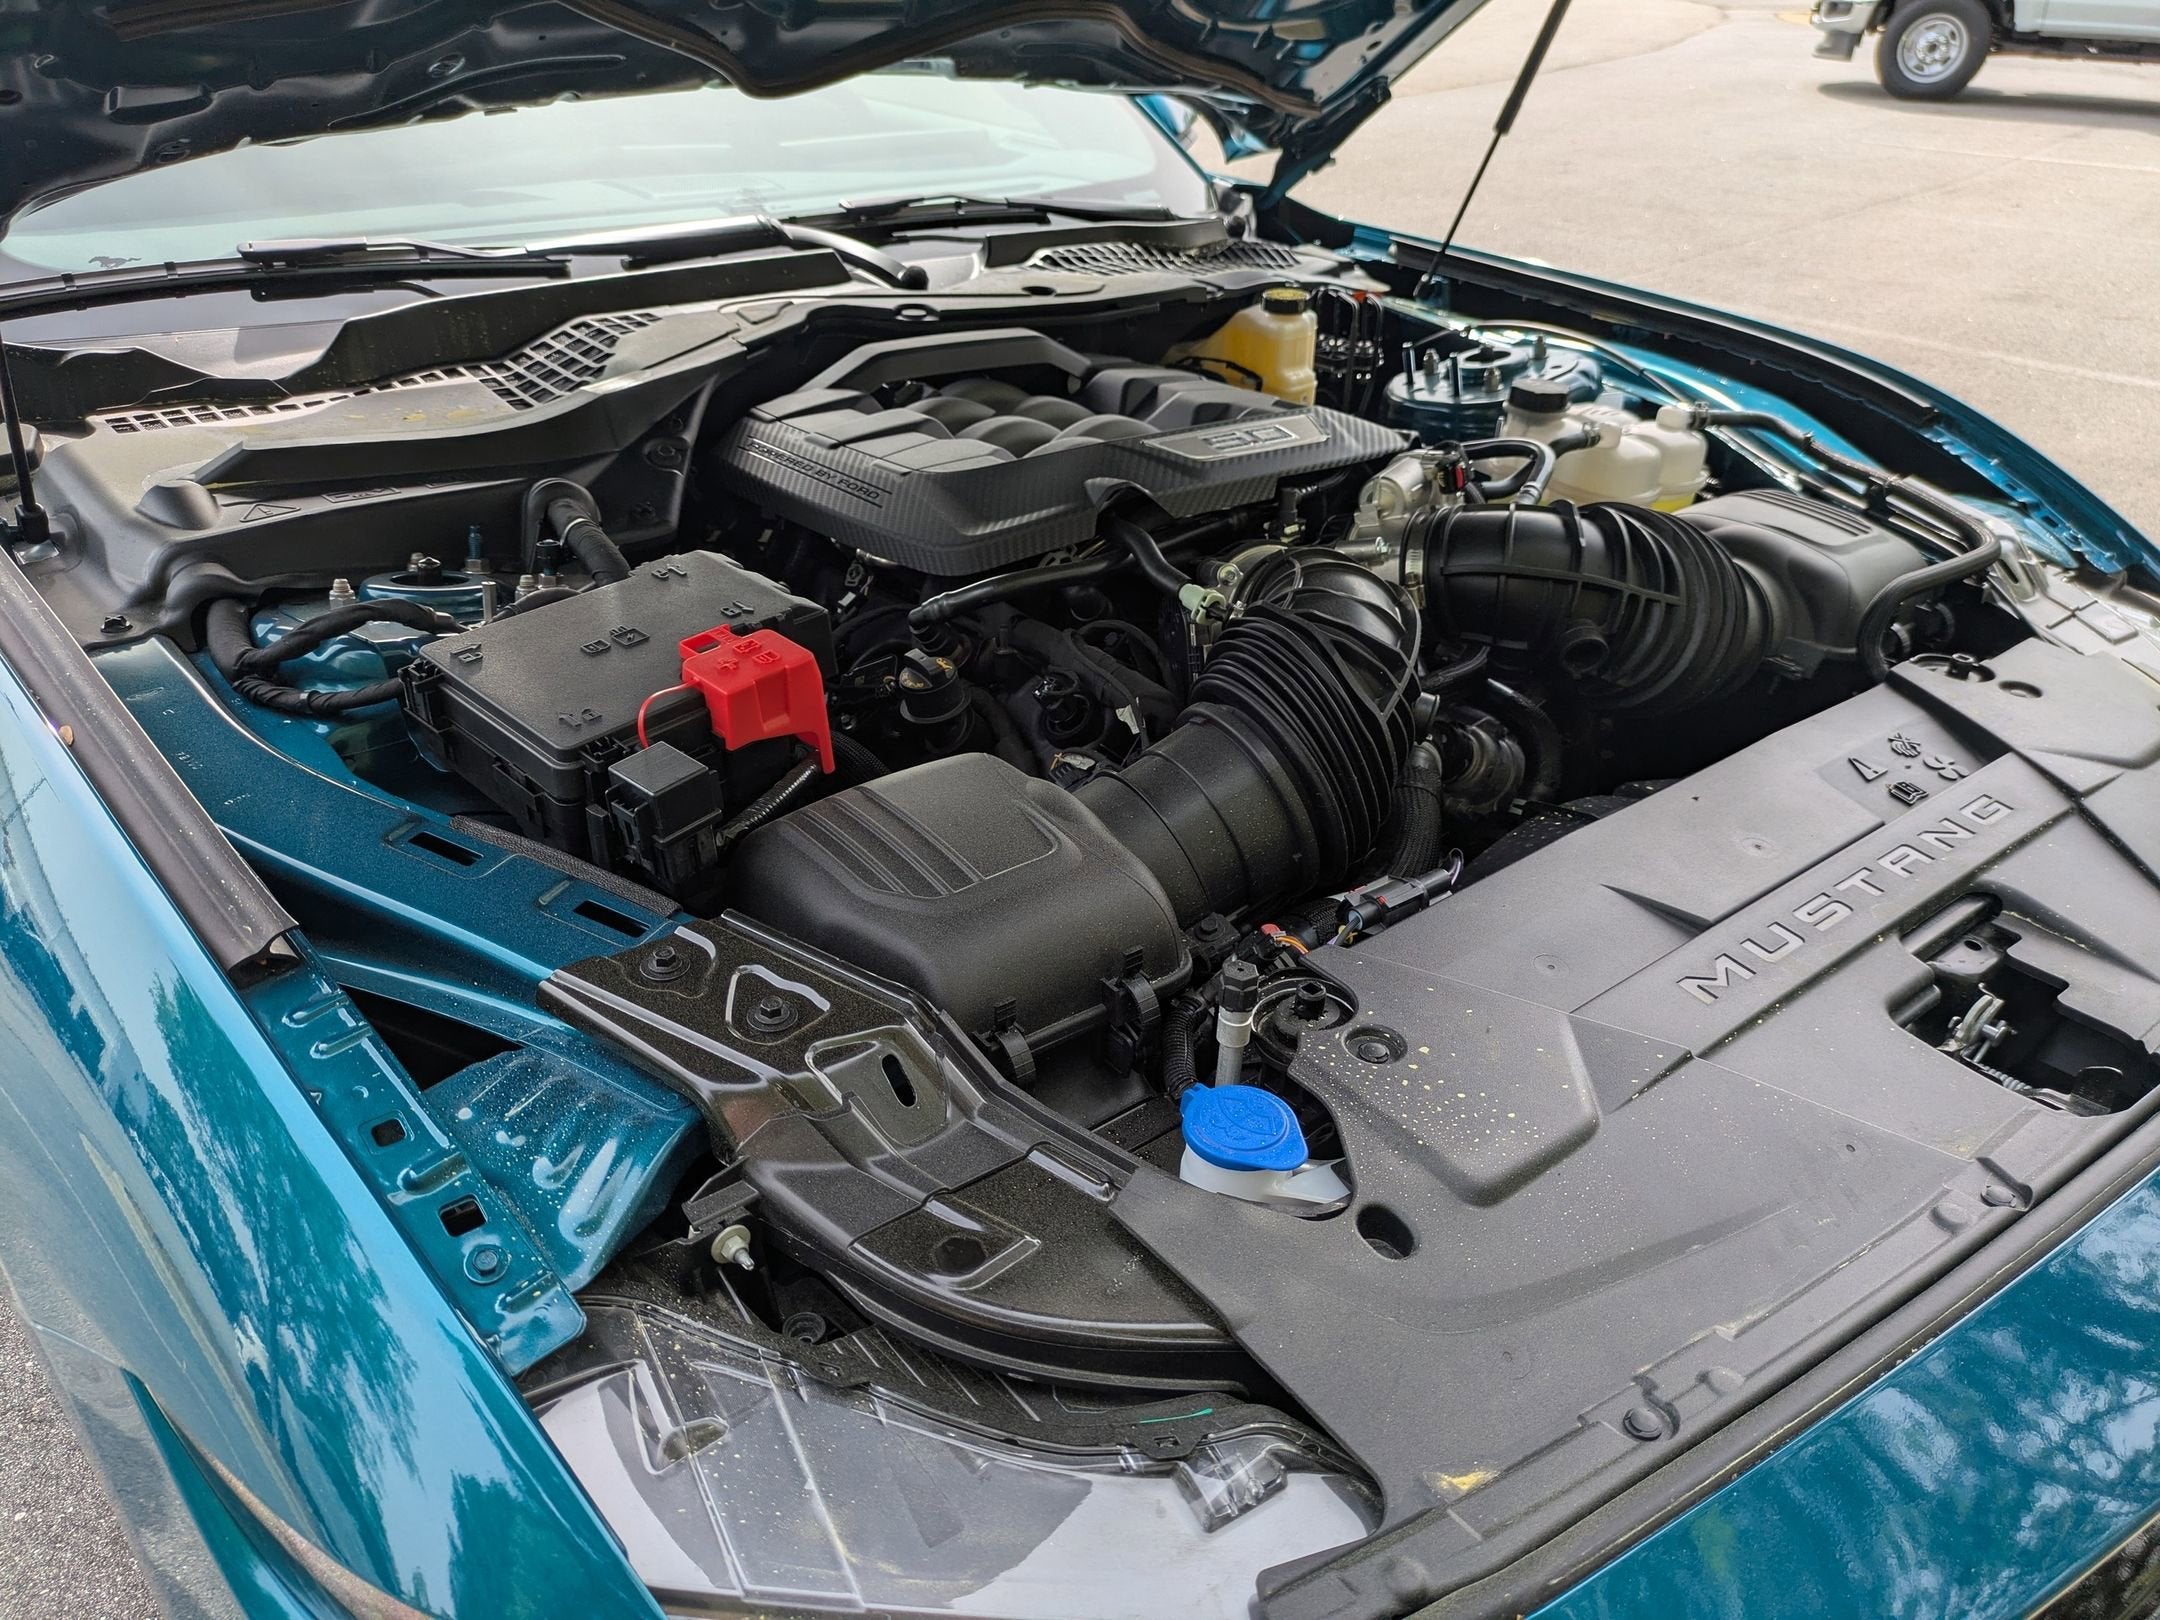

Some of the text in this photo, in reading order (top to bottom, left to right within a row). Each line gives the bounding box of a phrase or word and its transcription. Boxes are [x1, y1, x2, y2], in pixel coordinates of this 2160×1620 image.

[815, 468, 838, 481] BY
[837, 477, 881, 500] FORD
[1676, 793, 2014, 1005] MUSTANG
